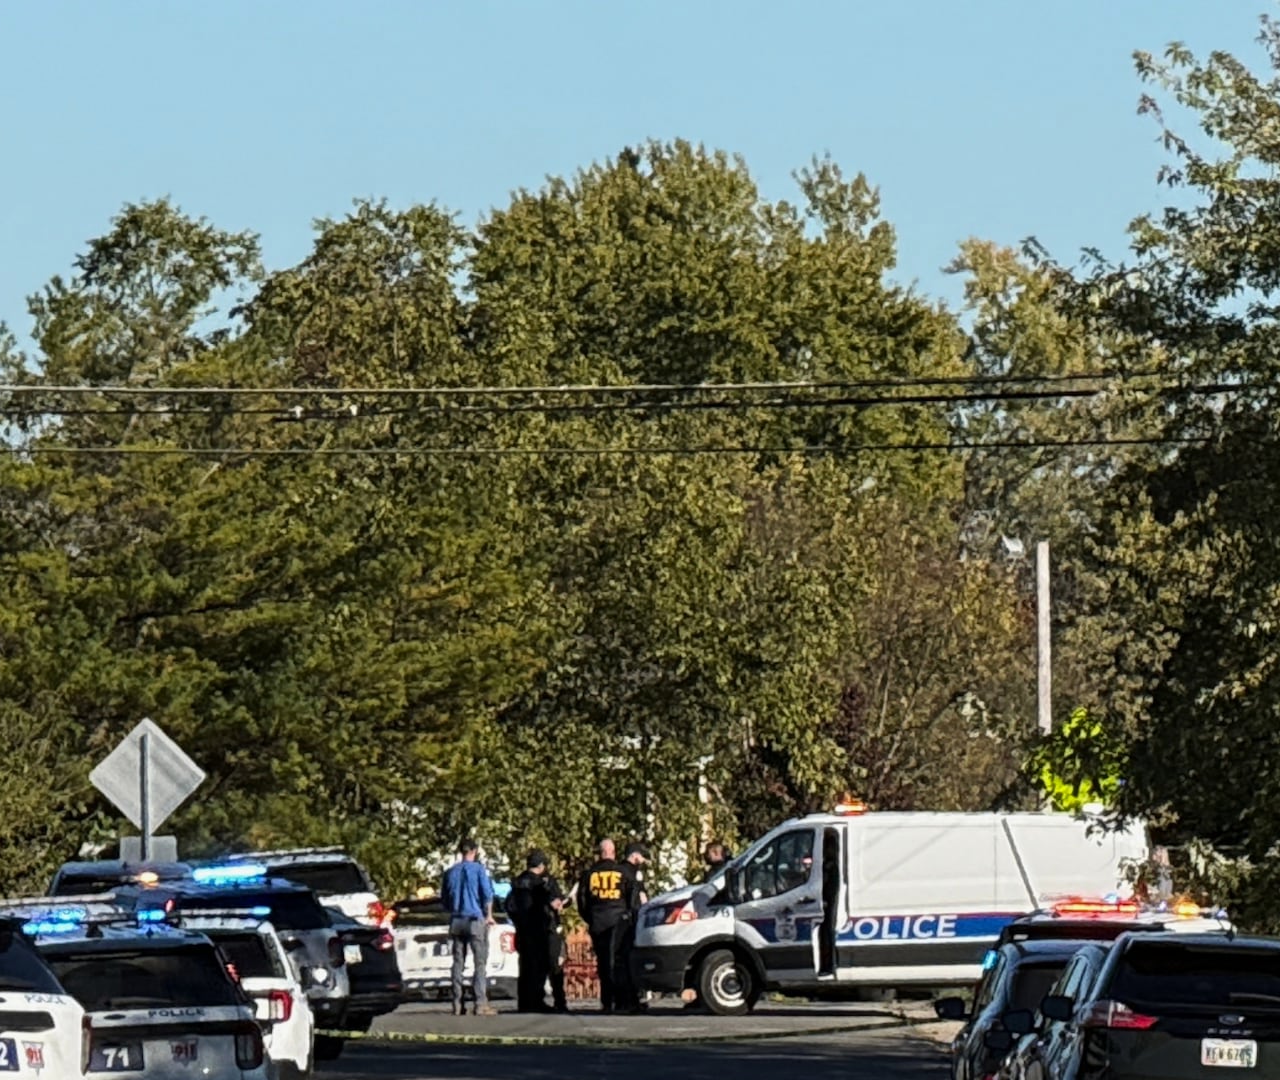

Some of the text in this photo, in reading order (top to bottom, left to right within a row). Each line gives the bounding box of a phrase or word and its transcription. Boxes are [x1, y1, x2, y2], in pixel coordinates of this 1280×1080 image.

[589, 871, 622, 890] ATF
[147, 1007, 206, 1018] POLICE
[102, 1047, 129, 1069] 71
